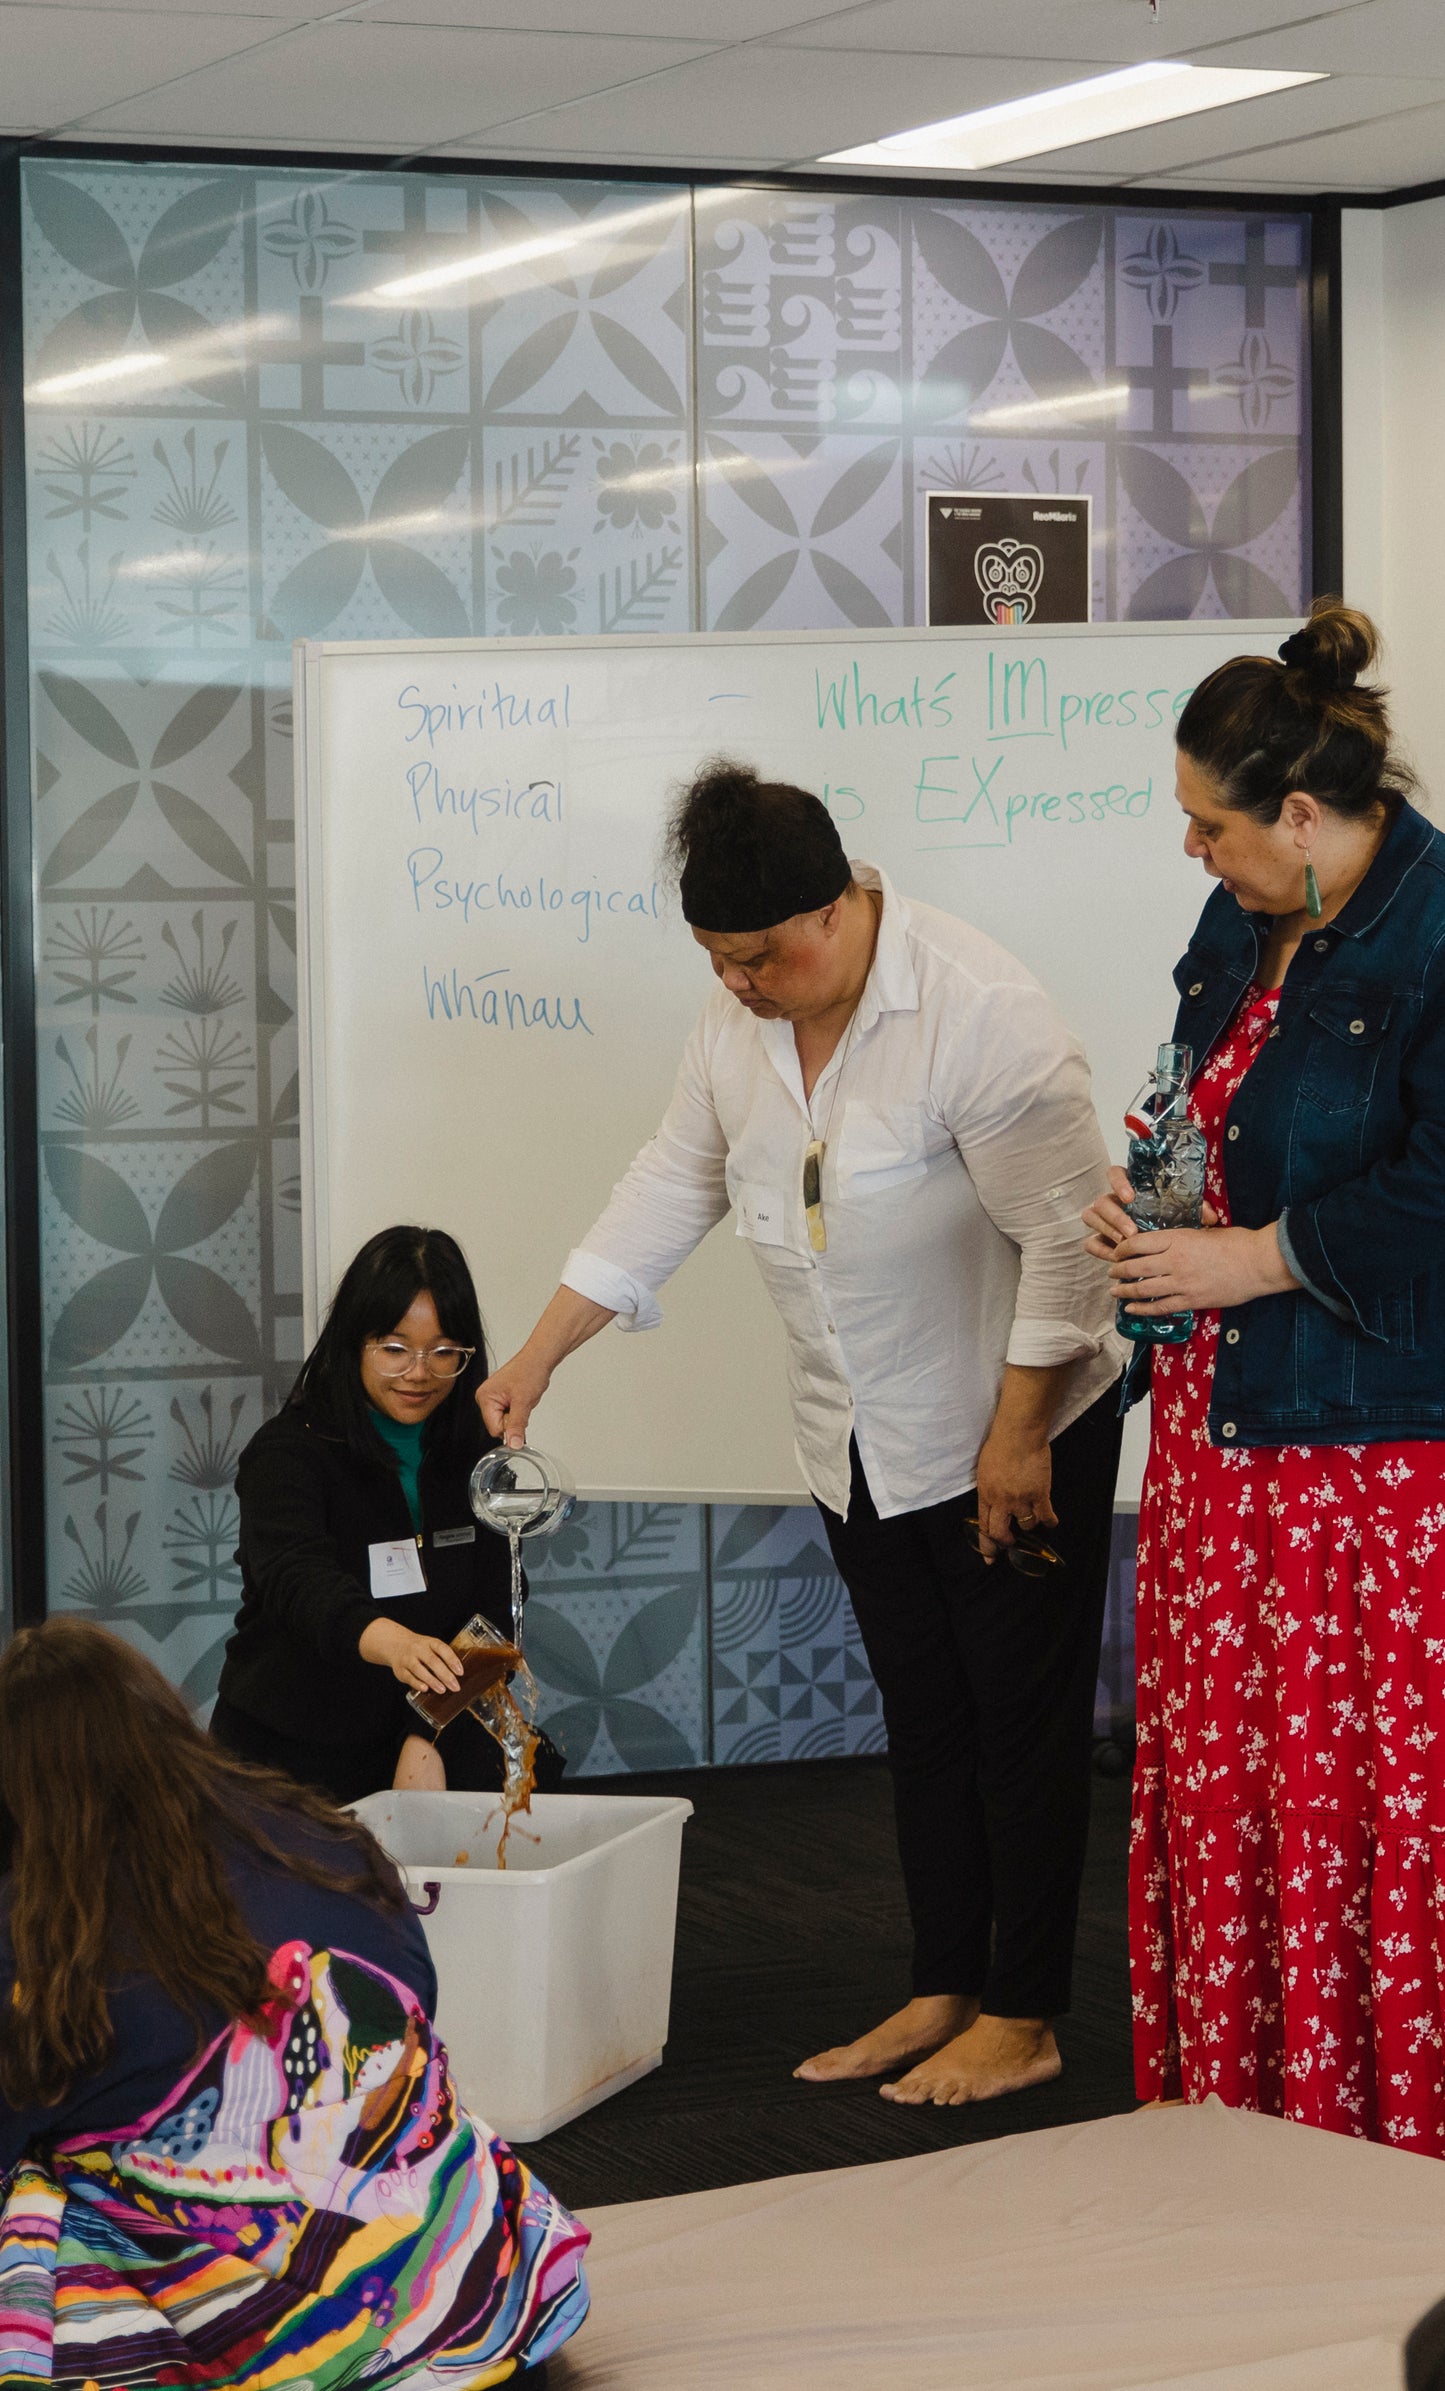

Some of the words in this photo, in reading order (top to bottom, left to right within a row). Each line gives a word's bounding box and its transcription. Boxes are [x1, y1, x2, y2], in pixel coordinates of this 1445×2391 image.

[398, 682, 570, 748] Spiritual
[814, 660, 957, 730] What's
[405, 761, 563, 835] Physical
[823, 771, 866, 822] is
[914, 754, 1153, 844] EXpressed
[406, 846, 660, 944] Psychological
[423, 964, 594, 1036] Whānau
